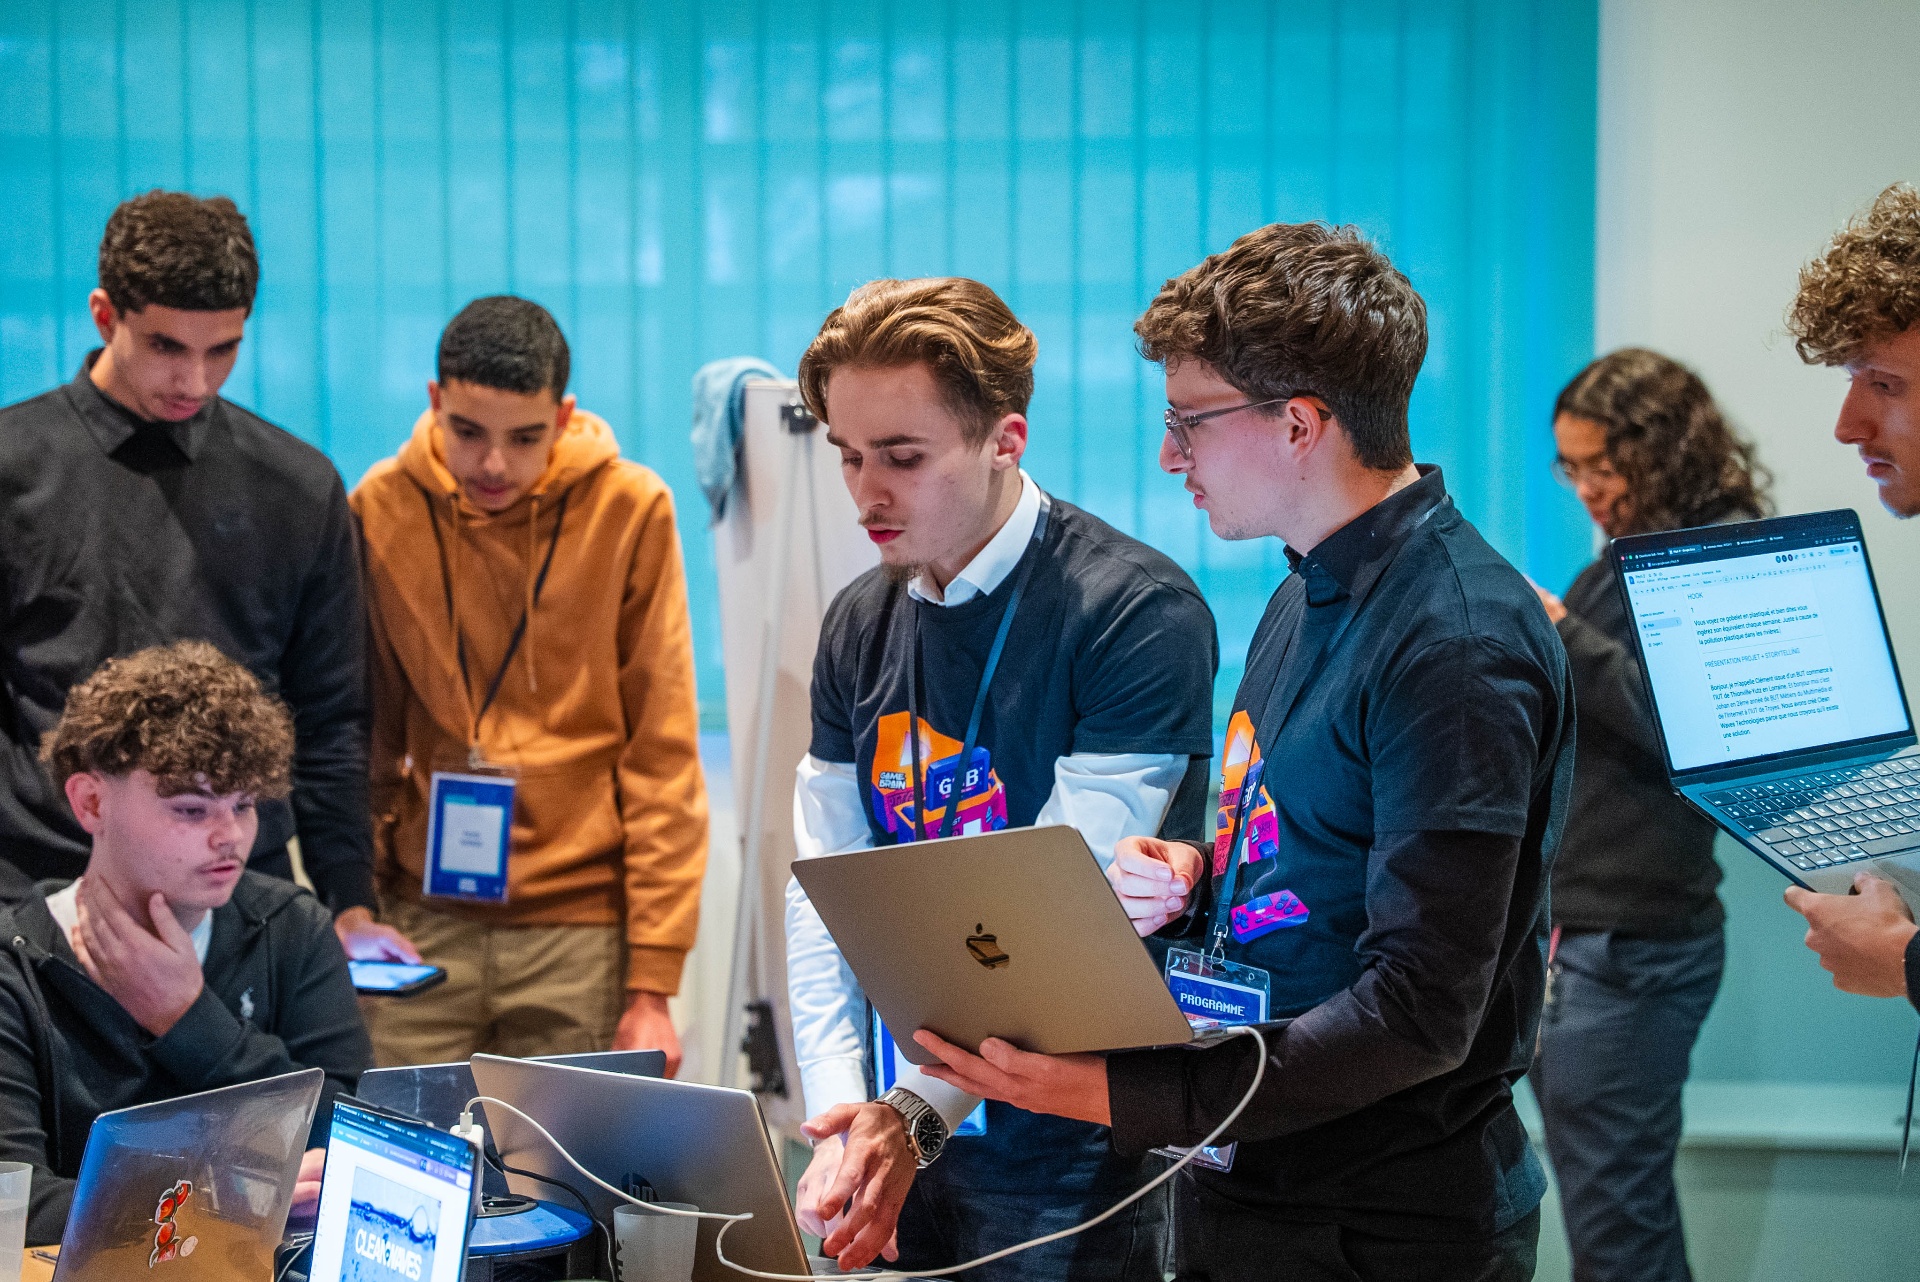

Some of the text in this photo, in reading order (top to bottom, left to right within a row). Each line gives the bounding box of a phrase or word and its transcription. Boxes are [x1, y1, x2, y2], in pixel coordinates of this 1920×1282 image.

[1687, 592, 1703, 600] HOOK
[1725, 614, 1743, 623] gobelet
[1745, 621, 1762, 629] chaque
[1703, 637, 1724, 645] pollution
[1723, 633, 1744, 642] plastique
[1741, 653, 1760, 662] PROJET
[1764, 647, 1800, 659] STORYTELLING
[1733, 678, 1755, 687] m'appelle
[1754, 676, 1774, 684] Clément
[1795, 670, 1805, 678] BUT
[1793, 680, 1810, 688] bonjour
[1769, 693, 1779, 702] BUT
[1735, 717, 1766, 726] Technologies
[1798, 708, 1816, 716] croyons
[880, 772, 905, 780] GAME
[879, 779, 906, 790] BRAIN
[939, 769, 979, 795] GB
[1180, 993, 1245, 1017] PROGRAMME
[356, 1228, 423, 1282] CLEAN WAVES
